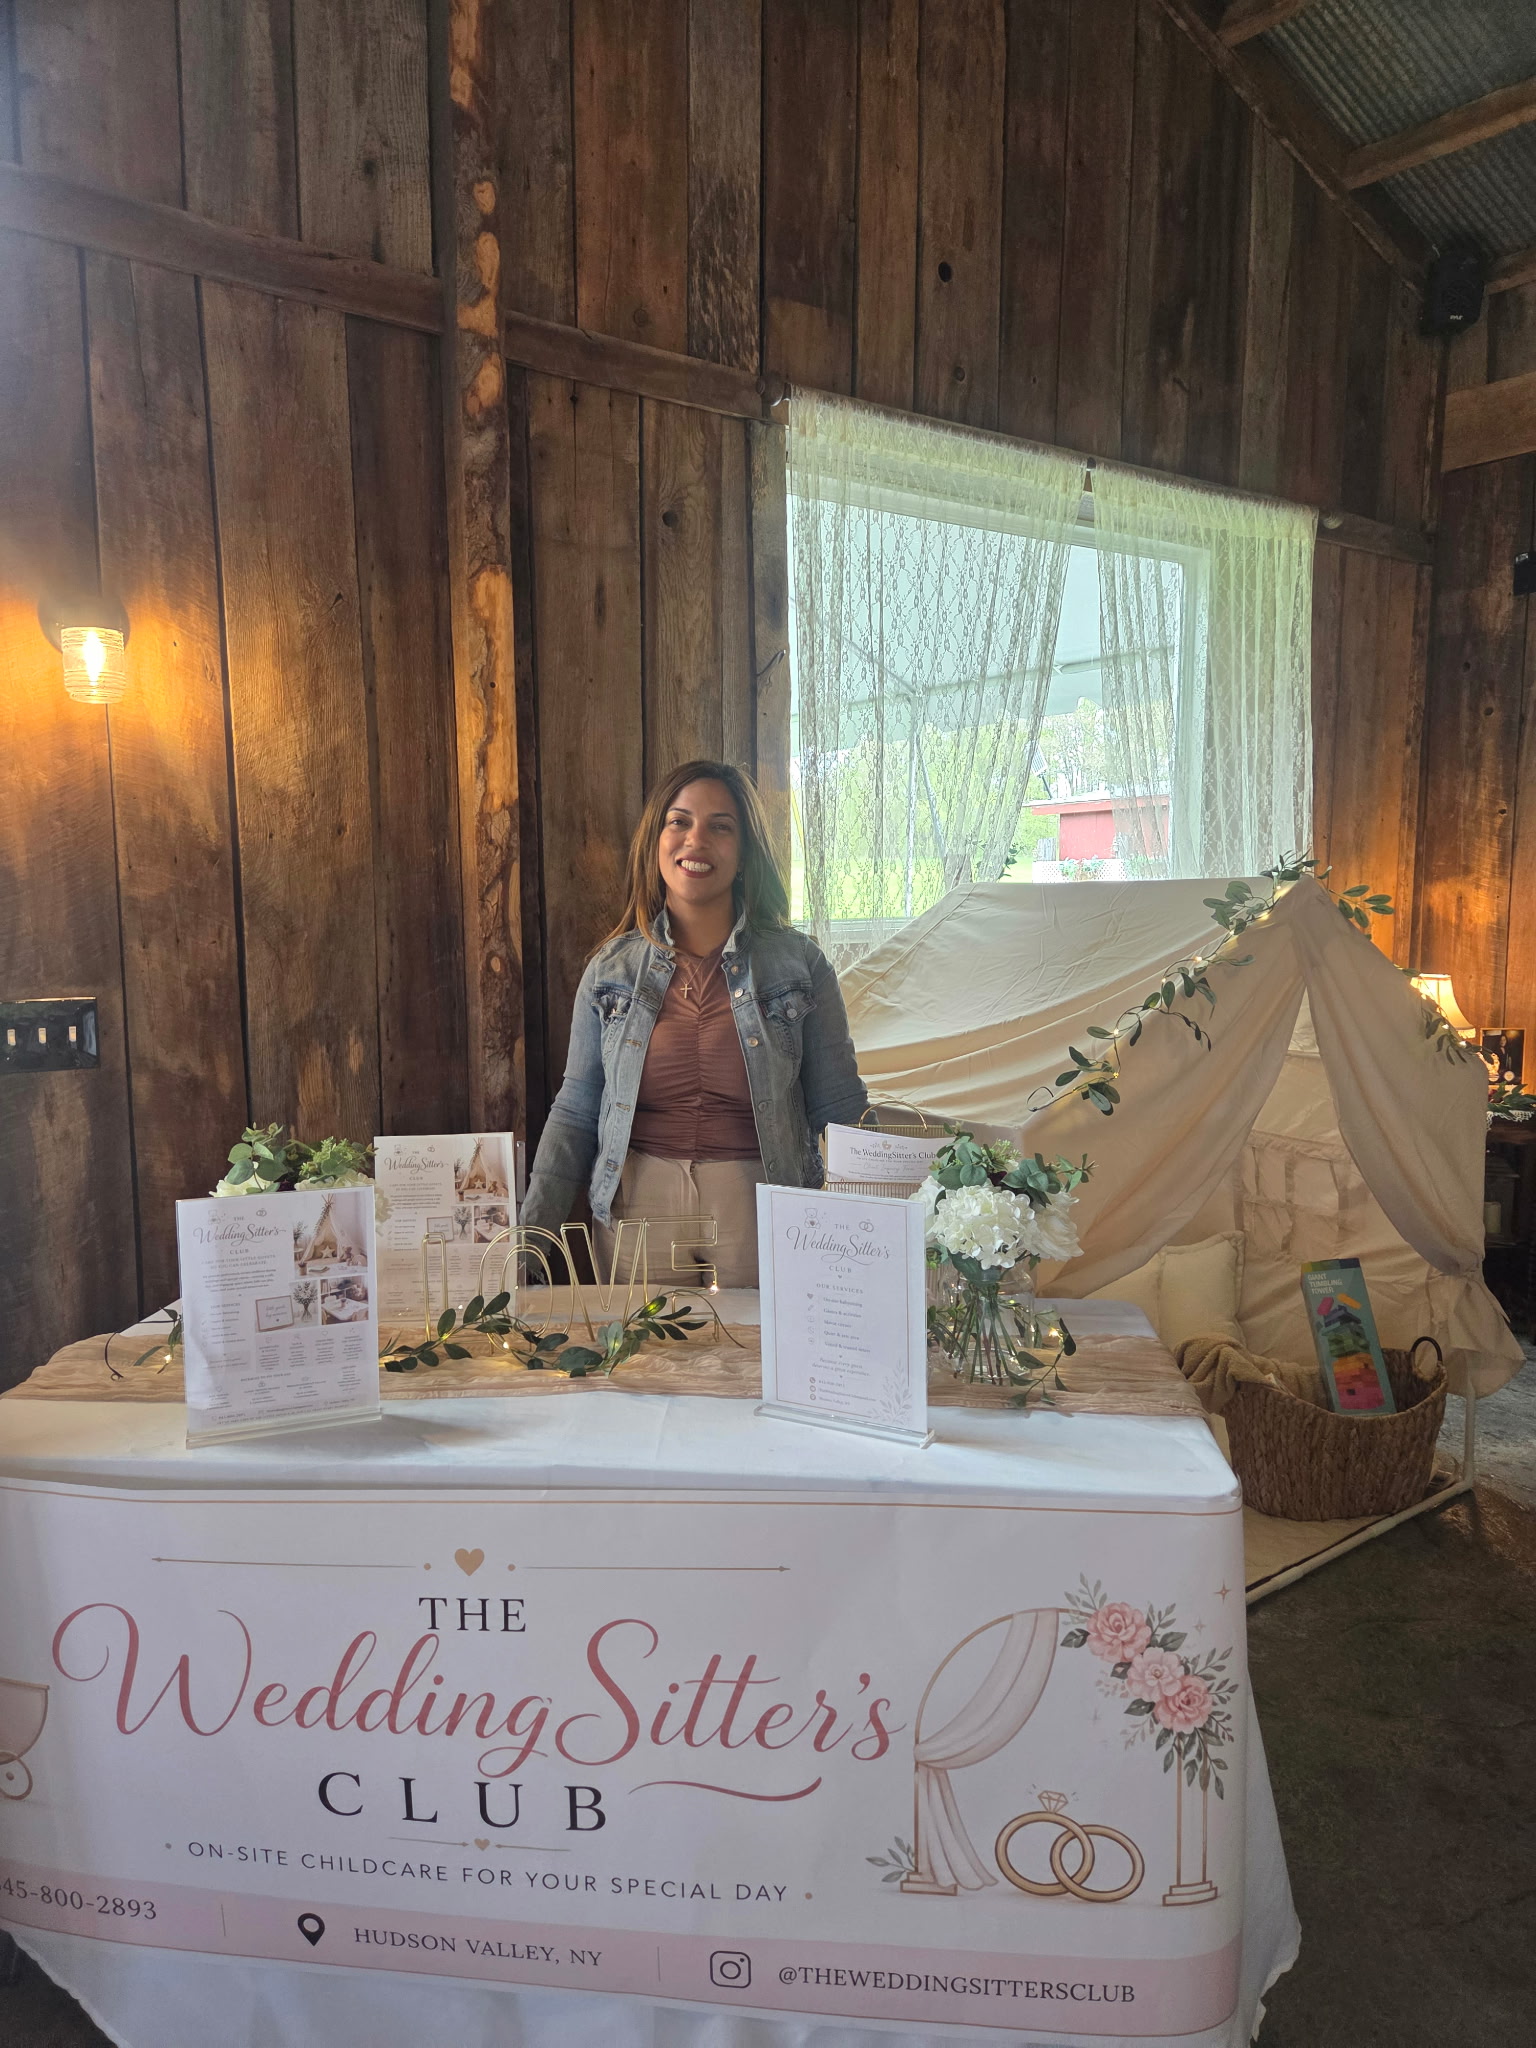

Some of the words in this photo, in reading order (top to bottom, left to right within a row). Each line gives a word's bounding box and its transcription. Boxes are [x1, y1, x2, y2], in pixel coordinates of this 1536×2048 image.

[850, 1147, 861, 1156] The
[834, 1223, 850, 1231] THE
[829, 1265, 852, 1273] CLUB
[833, 1285, 863, 1294] SERVICES
[1310, 1279, 1343, 1288] TUMBLING
[1312, 1286, 1334, 1295] TOWER
[419, 1597, 527, 1633] THE
[317, 1771, 607, 1832] CLUB
[188, 1841, 289, 1866] ON-SITE
[301, 1853, 449, 1882] CHILDCARE
[462, 1867, 512, 1886] FOR
[525, 1871, 597, 1893] YOUR
[611, 1877, 721, 1900] SPECIAL
[736, 1883, 788, 1901] DAY
[0, 1877, 157, 1920] 45-800-2893
[353, 1928, 456, 1953] HUDSON
[465, 1938, 560, 1965] VALLEY,
[570, 1949, 603, 1966] NY
[778, 1966, 1135, 2004] @THEWEDDINGSITTERSCLUB
